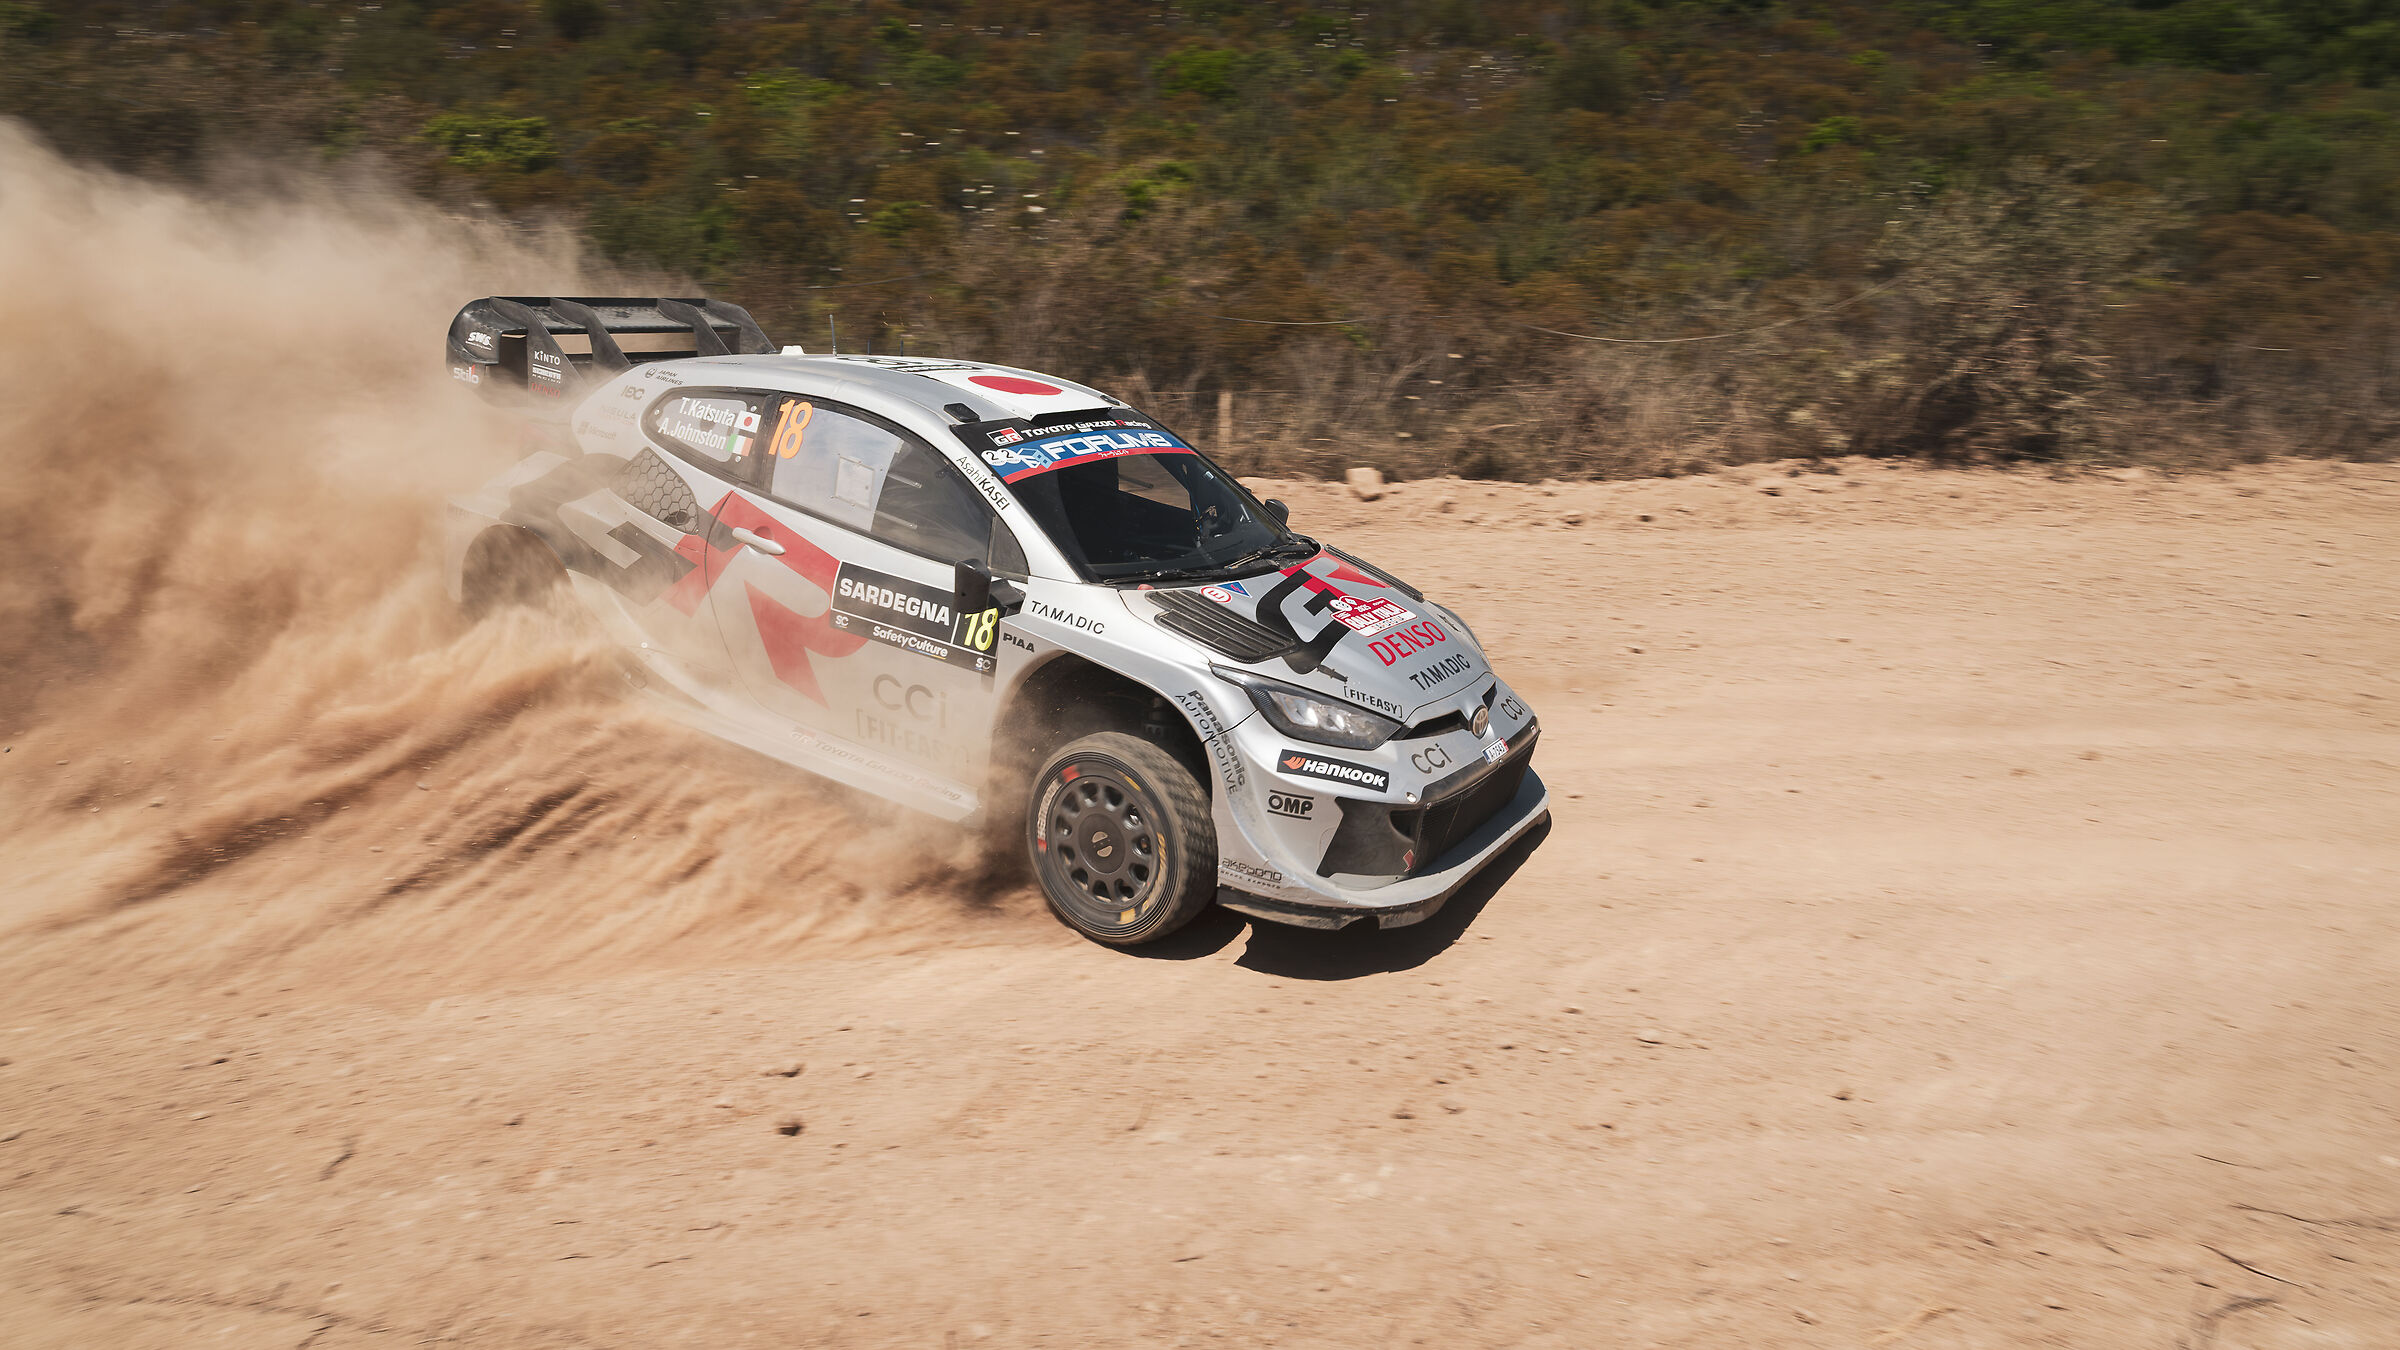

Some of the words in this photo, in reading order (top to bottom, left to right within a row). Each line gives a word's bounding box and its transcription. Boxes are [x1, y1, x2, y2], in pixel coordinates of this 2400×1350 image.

[656, 375, 684, 386] AIRLINES
[658, 370, 678, 378] JAPAN
[680, 396, 735, 427] T.Katsuta
[657, 417, 727, 450] A.Johnston
[768, 400, 813, 459] 18
[1022, 424, 1075, 440] TOYOTA
[839, 577, 951, 627] SARDEGNA
[964, 608, 999, 651] 18
[1031, 600, 1105, 635] TAMADIC
[872, 625, 948, 657] SafetyCulture
[1002, 632, 1035, 653] PIAA
[1367, 620, 1447, 667] DENSO
[1409, 653, 1472, 691] TAMADIC
[1174, 694, 1237, 796] AUTOMOTIVE
[1187, 689, 1246, 787] Panasonic
[1268, 794, 1314, 816] OMP
